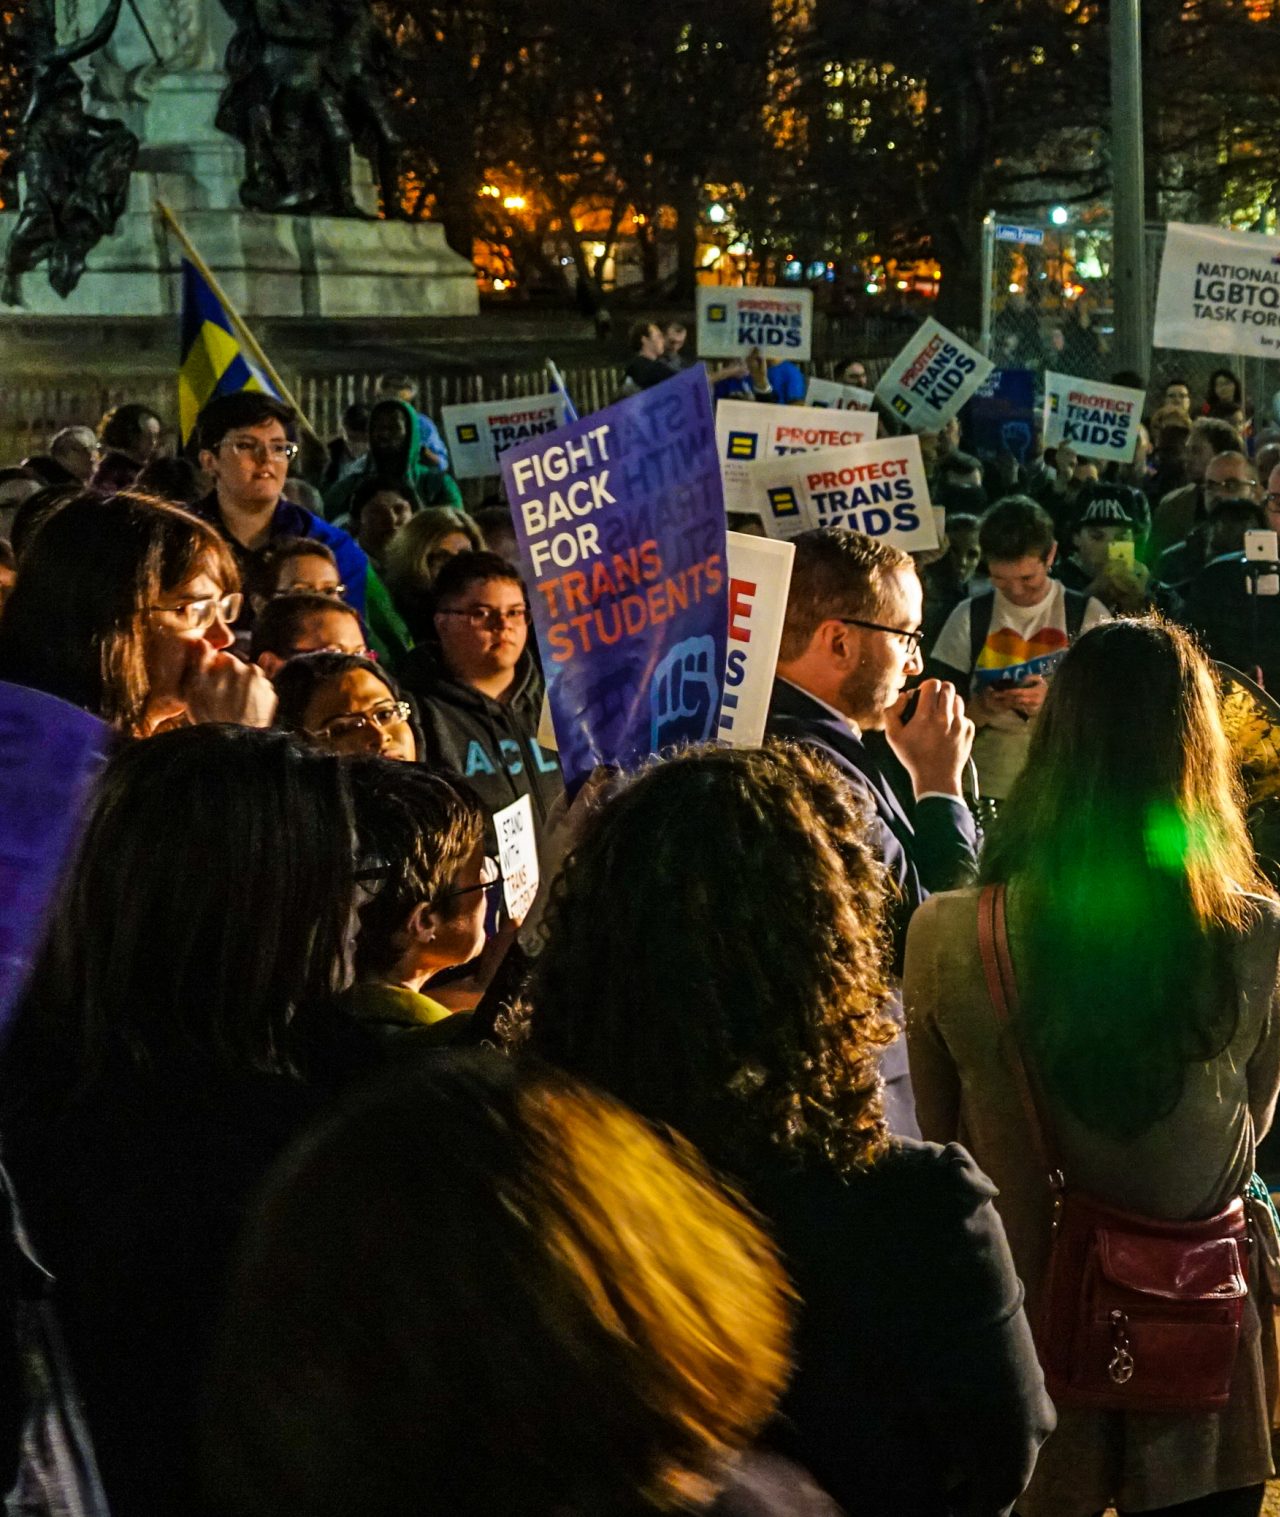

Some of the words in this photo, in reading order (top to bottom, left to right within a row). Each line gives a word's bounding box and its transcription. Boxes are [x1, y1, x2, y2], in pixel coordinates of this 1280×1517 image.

[1197, 262, 1280, 284] NATIONAL
[1194, 279, 1280, 309] LGBTQ
[738, 311, 801, 328] TRANS
[1193, 303, 1236, 321] TASK
[738, 327, 802, 347] KIDS
[1260, 335, 1273, 346] be
[901, 334, 944, 387] PROTECT
[911, 344, 959, 396] TRANS
[925, 353, 976, 410] KIDS
[1067, 404, 1131, 428] TRANS
[1069, 391, 1134, 413] PROTECT
[488, 407, 555, 426] PROTECT
[491, 420, 558, 441] TRANS
[776, 425, 865, 446] PROTECT
[1063, 421, 1127, 448] KIDS
[512, 425, 610, 495] FIGHT
[807, 459, 908, 490] PROTECT
[521, 470, 616, 537] BACK
[811, 479, 914, 515] TRANS
[529, 522, 602, 577] FOR
[537, 539, 663, 619] TRANS
[547, 555, 723, 662] STUDENTS
